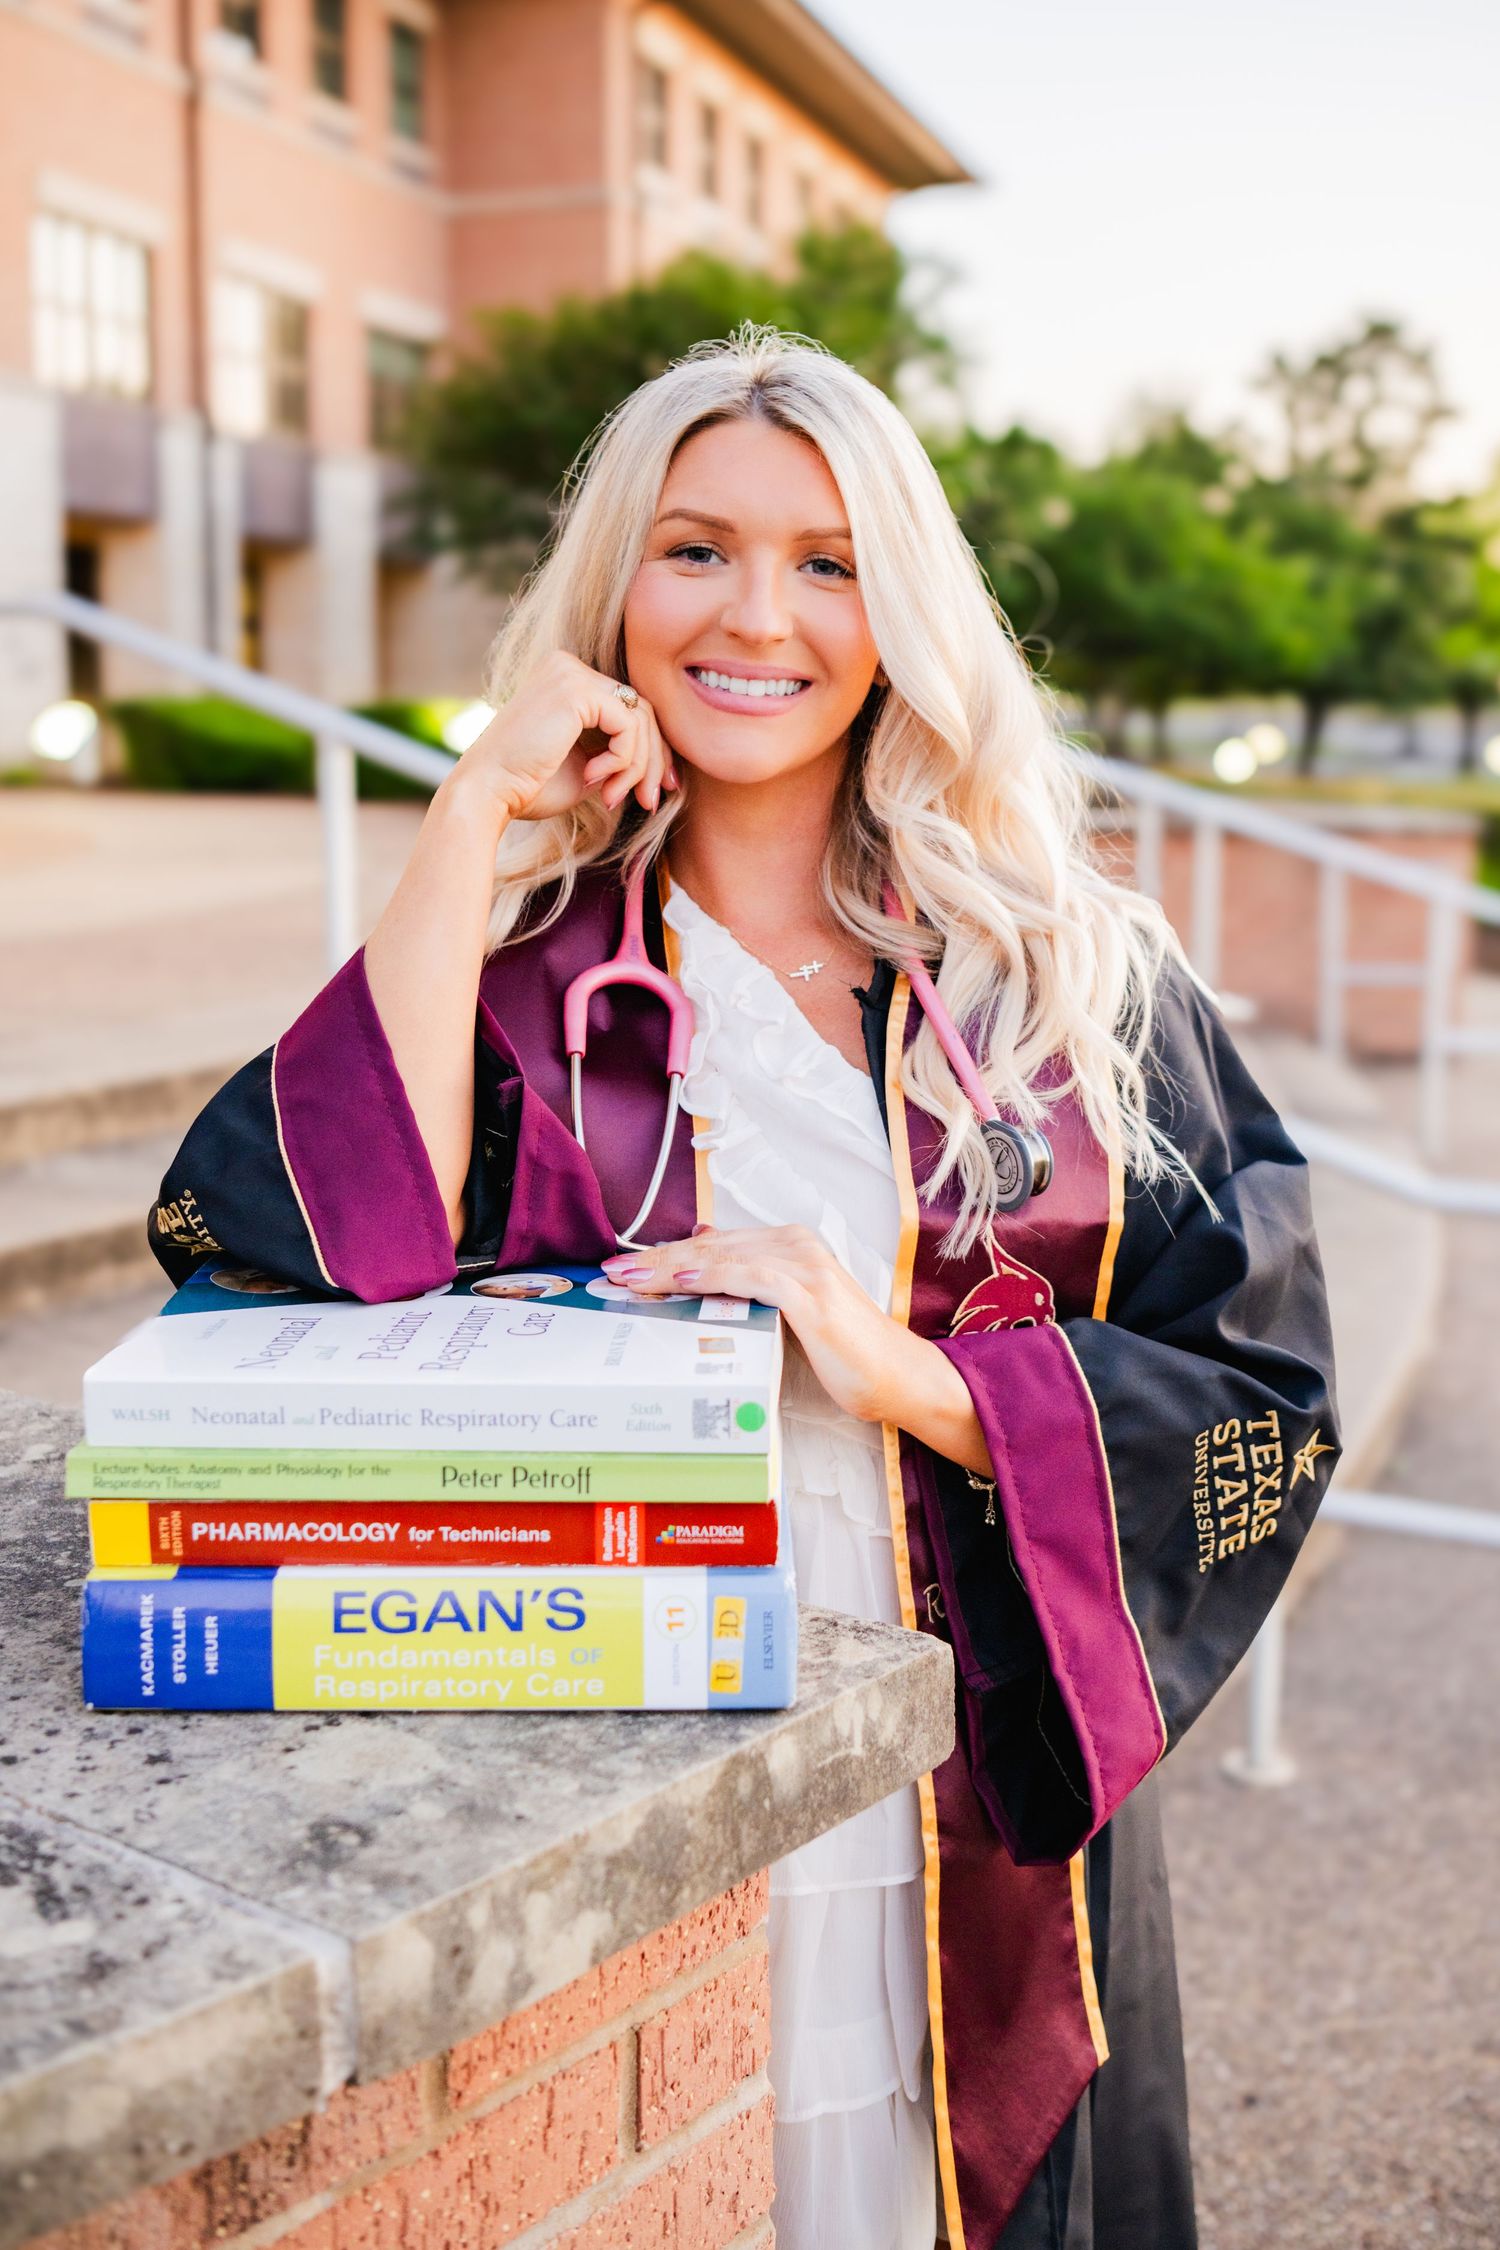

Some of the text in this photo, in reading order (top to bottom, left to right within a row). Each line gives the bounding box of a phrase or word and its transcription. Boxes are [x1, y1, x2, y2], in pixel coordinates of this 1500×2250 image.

[357, 1311, 432, 1360] Pediatric
[418, 1305, 510, 1372] Respiratory
[507, 1312, 556, 1336] Care
[234, 1317, 322, 1369] Neonatal
[111, 1408, 171, 1422] WALSH
[190, 1406, 286, 1426] Neonatal
[318, 1407, 412, 1428] Pediatric
[420, 1408, 541, 1433] Respiratory
[549, 1408, 599, 1428] Care
[625, 1418, 672, 1433] Edition
[92, 1462, 140, 1475] Lecture
[187, 1463, 243, 1477] Anatomy
[247, 1464, 272, 1476] and
[275, 1464, 343, 1480] Physiology
[347, 1464, 367, 1480] for
[370, 1464, 392, 1477] the
[92, 1476, 222, 1492] Respiratory Therapist
[441, 1466, 592, 1495] Peter Petroff
[1246, 1410, 1284, 1544] TEXAS
[1212, 1418, 1249, 1560] STATE
[159, 1516, 171, 1551] SIXTH
[171, 1510, 184, 1557] EDITION
[191, 1522, 551, 1544] PHARMACOLOGY for Technicians
[675, 1525, 745, 1538] PARADIGM
[332, 1586, 587, 1634] EGAN'S
[666, 1606, 685, 1632] 11
[140, 1592, 155, 1697] KACMAREK
[172, 1605, 187, 1685] STOLLER
[205, 1614, 219, 1676] HEUER
[314, 1643, 605, 1670] Fundamentals OF
[762, 1610, 774, 1671] ELSEVIER
[314, 1672, 605, 1702] Respiratory Care
